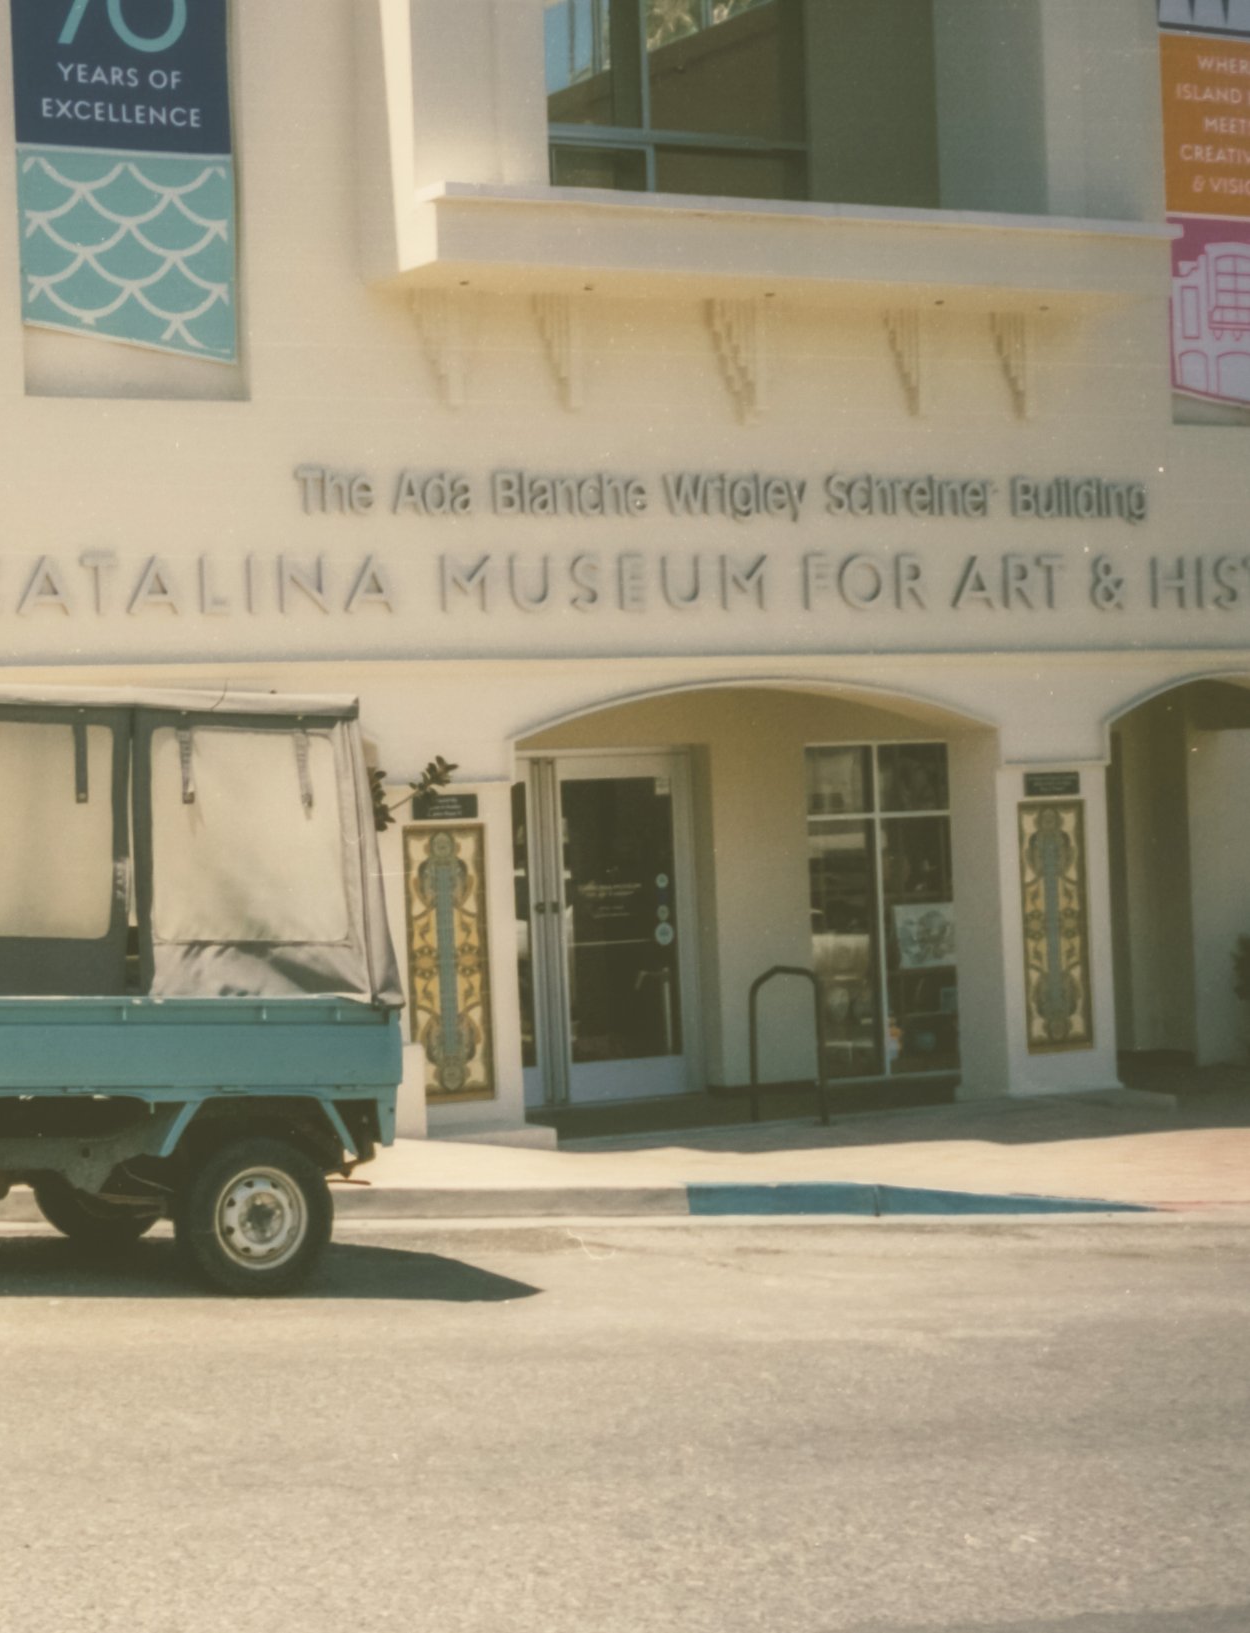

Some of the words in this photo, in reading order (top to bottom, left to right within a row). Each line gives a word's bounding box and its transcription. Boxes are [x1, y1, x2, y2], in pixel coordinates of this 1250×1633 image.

[57, 62, 139, 87] YEARS
[148, 70, 182, 90] OF
[1176, 82, 1243, 104] ISLAND
[41, 98, 202, 128] EXCELLENCE
[1203, 116, 1250, 135] MEET
[293, 464, 375, 515] The
[390, 470, 472, 515] Ada
[490, 470, 648, 516] Blanche
[662, 473, 805, 521] Wrigley
[823, 473, 990, 518] Schreiner
[1008, 475, 1147, 523] Building
[438, 552, 768, 615] MUSEUM
[802, 551, 924, 612] FOR
[949, 553, 1061, 612] ART
[1090, 553, 1124, 611] &
[1149, 555, 1250, 611] HIS
